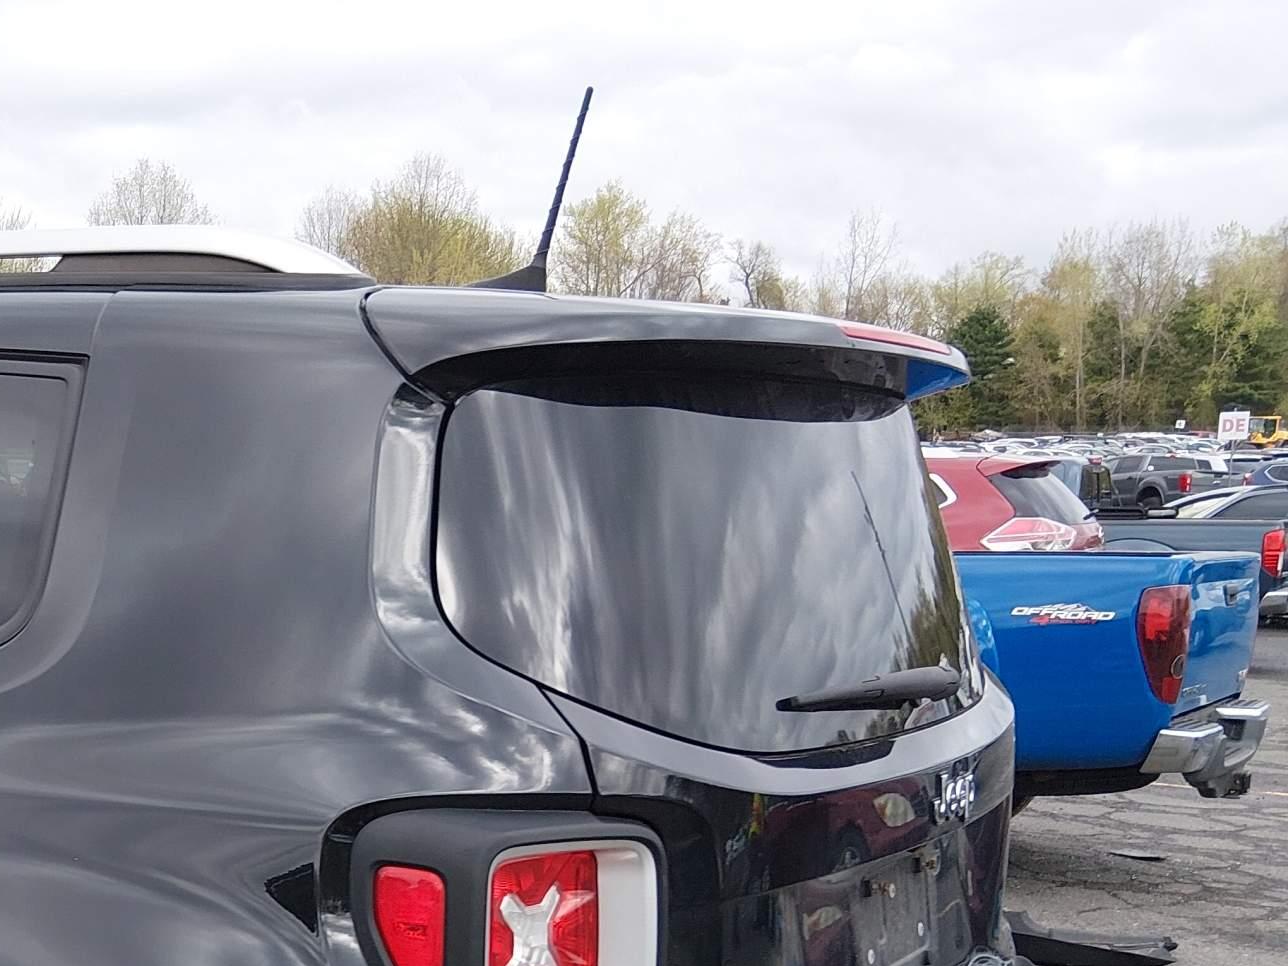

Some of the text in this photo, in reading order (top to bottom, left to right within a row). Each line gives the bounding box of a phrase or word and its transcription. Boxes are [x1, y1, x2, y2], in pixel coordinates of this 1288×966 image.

[1222, 418, 1246, 433] DE
[1011, 606, 1116, 621] OFFROAD
[933, 772, 975, 825] Jeep
